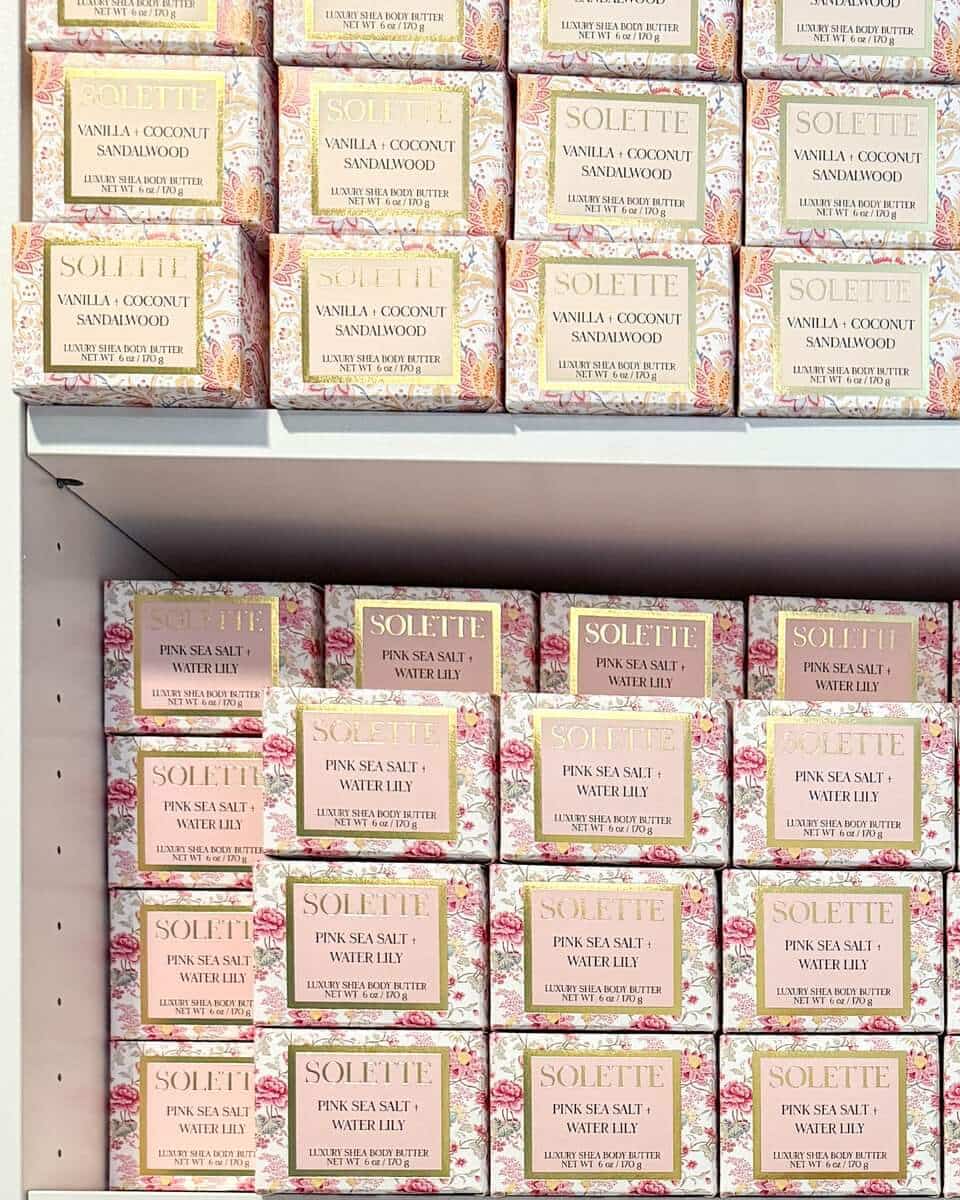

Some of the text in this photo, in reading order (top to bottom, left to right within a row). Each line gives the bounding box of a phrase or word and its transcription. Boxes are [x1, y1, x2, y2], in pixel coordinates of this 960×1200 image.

[794, 149, 845, 161] VANILLA
[858, 151, 921, 163] COCONUT
[812, 169, 902, 182] SANDALWOOD
[57, 294, 110, 306] VANILLA
[123, 295, 190, 307] COCONUT
[76, 314, 169, 326] SANDALWOOD
[64, 344, 183, 354] LUXURY SHEA BODY BUTTER
[370, 614, 485, 638] SOLETTE
[382, 650, 409, 660] PINK
[412, 650, 434, 661] SEA
[438, 652, 464, 662] SALT
[394, 668, 461, 680] WATER LILY
